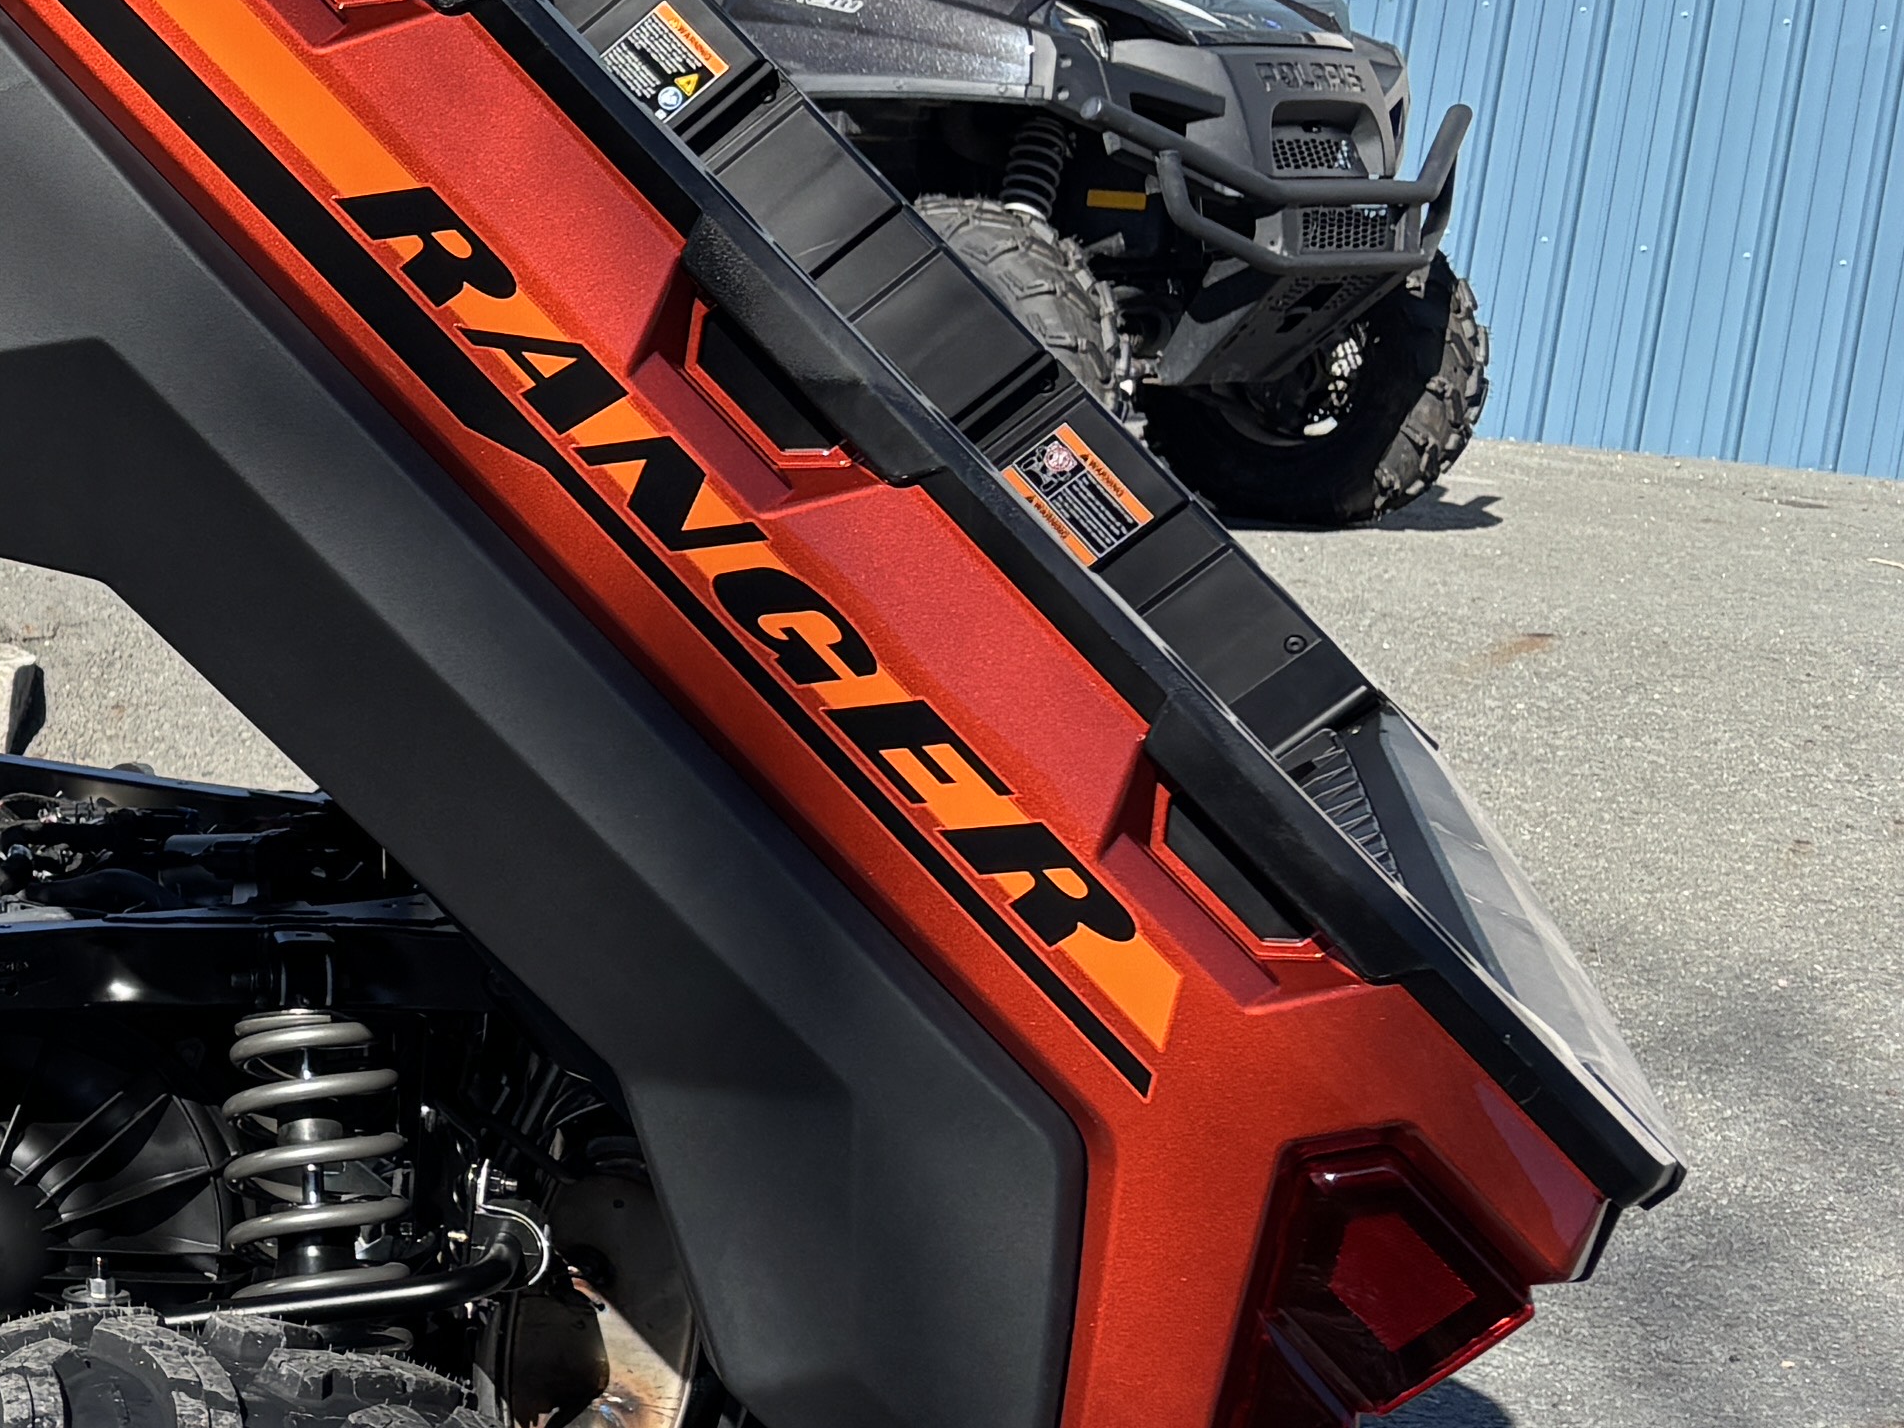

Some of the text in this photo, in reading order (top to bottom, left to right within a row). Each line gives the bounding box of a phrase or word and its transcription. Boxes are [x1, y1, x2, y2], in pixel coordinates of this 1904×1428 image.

[678, 26, 712, 61] WARNING
[1255, 61, 1366, 92] POLARIS
[1088, 459, 1126, 498] WARNING
[1033, 500, 1071, 540] WARNING
[338, 184, 1138, 949] RANGER
